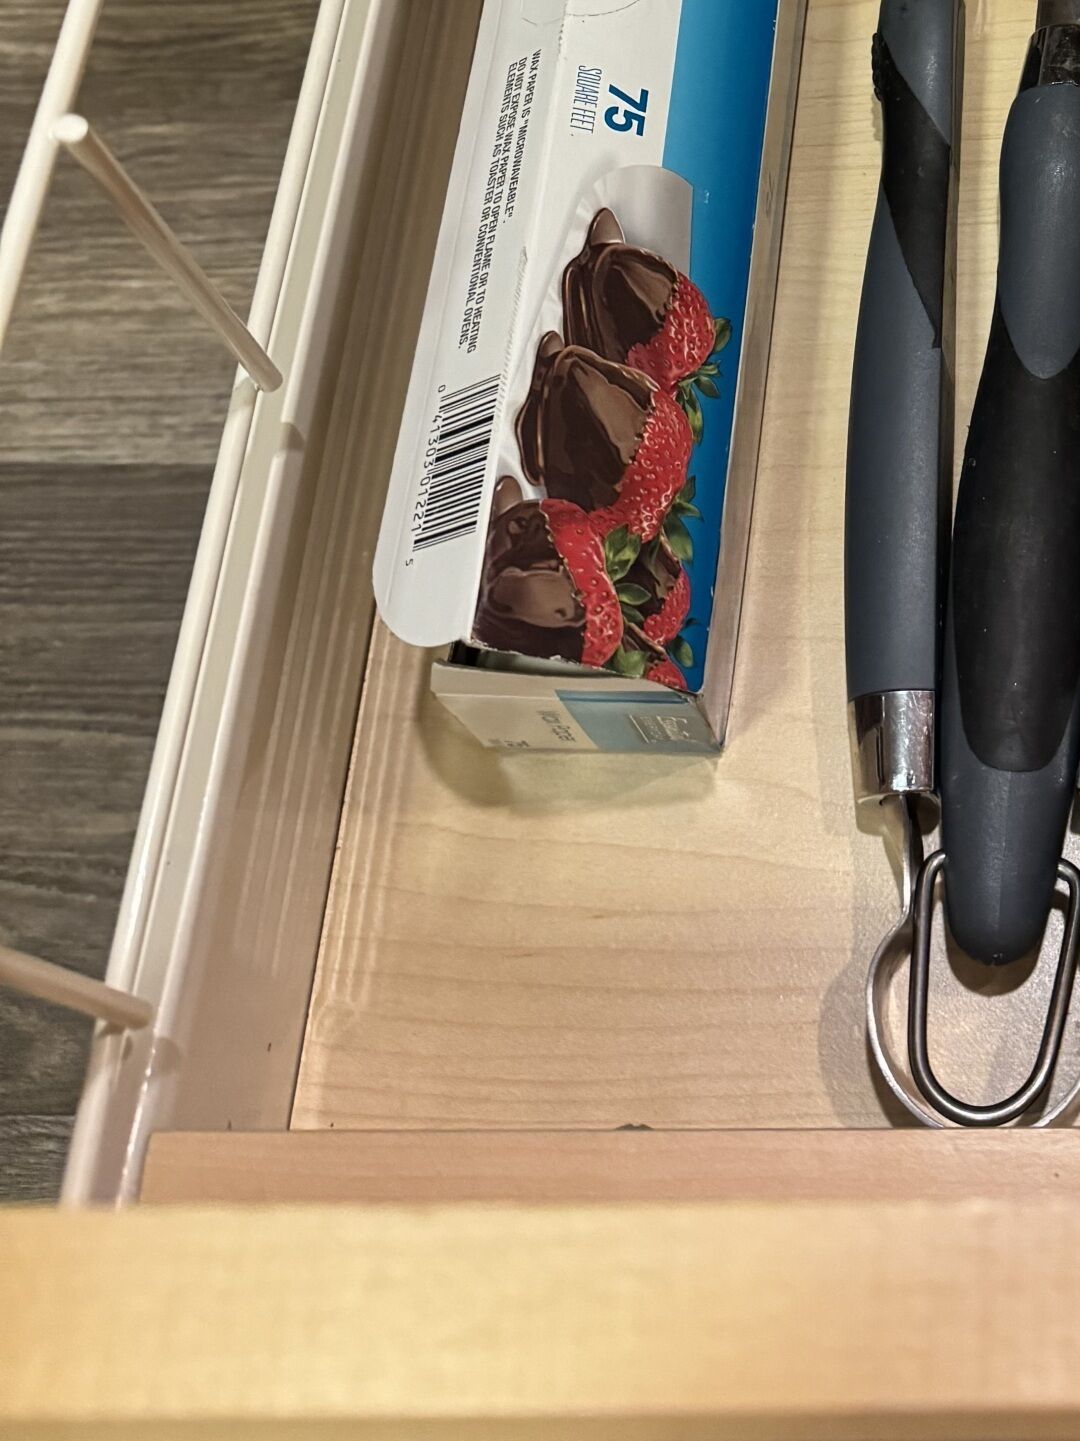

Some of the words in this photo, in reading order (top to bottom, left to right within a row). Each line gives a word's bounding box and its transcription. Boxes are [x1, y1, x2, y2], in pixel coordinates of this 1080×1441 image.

[517, 56, 528, 72] DO
[529, 48, 542, 73] WAX
[500, 62, 518, 114] ELEMENTS
[513, 71, 525, 92] NOT
[523, 73, 537, 106] PAPER
[573, 65, 603, 108] SQUARE
[506, 91, 521, 132] EXPOSE
[521, 106, 531, 119] IS
[604, 83, 650, 137] 75
[495, 113, 508, 142] SUCH
[492, 143, 502, 158] AS
[502, 130, 514, 156] WAX
[484, 157, 500, 206] TOASTER
[496, 155, 509, 189] PAPER
[493, 188, 504, 204] TO
[480, 206, 491, 222] OR
[487, 205, 500, 234] OPEN
[465, 222, 488, 307] CONVENTIONAL
[481, 233, 496, 271] FLAME
[478, 272, 489, 289] OR
[475, 288, 487, 305] TO
[458, 307, 474, 349] OVENS.
[467, 305, 483, 354] HEATING
[438, 384, 446, 393] 0
[424, 415, 442, 469] 41303
[411, 476, 430, 532] 01221
[405, 558, 414, 567] 5
